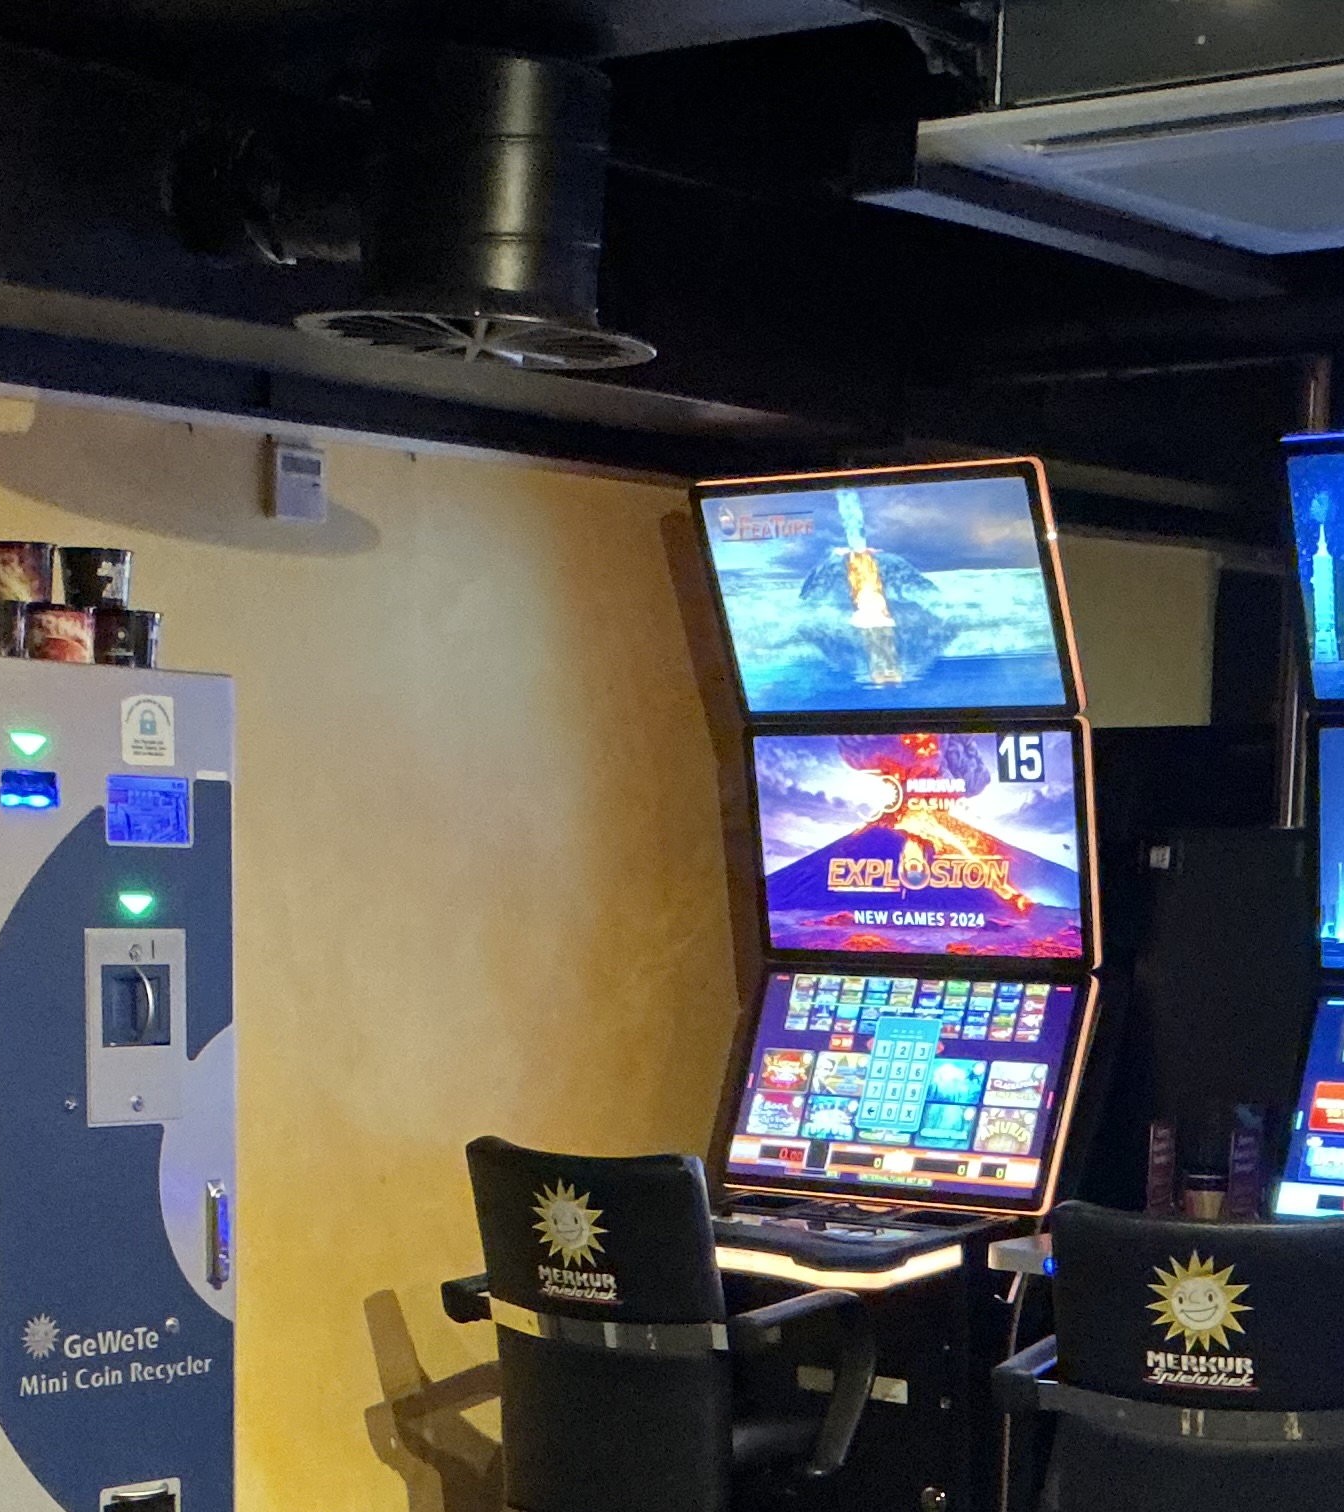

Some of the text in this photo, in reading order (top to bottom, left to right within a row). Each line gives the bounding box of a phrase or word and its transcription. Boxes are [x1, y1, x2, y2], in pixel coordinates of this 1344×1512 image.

[999, 736, 1042, 780] 15
[827, 857, 1010, 890] EXPLOSION
[854, 910, 985, 927] NEW GAMES 2024
[900, 1046, 907, 1056] 2
[919, 1047, 926, 1057] 3
[895, 1067, 902, 1076] 5
[915, 1068, 921, 1077] 6
[891, 1087, 897, 1097] 8
[910, 1089, 916, 1098] 9
[779, 1147, 804, 1161] 0.00
[957, 1164, 966, 1176] 0
[996, 1168, 1004, 1180] 0
[537, 1264, 617, 1289] MERKUR
[63, 1326, 159, 1359] GeWeTe
[1146, 1350, 1254, 1375] MERKUR
[20, 1355, 213, 1397] Mini Coin Recycler
[1147, 1367, 1254, 1386] Spielothek
